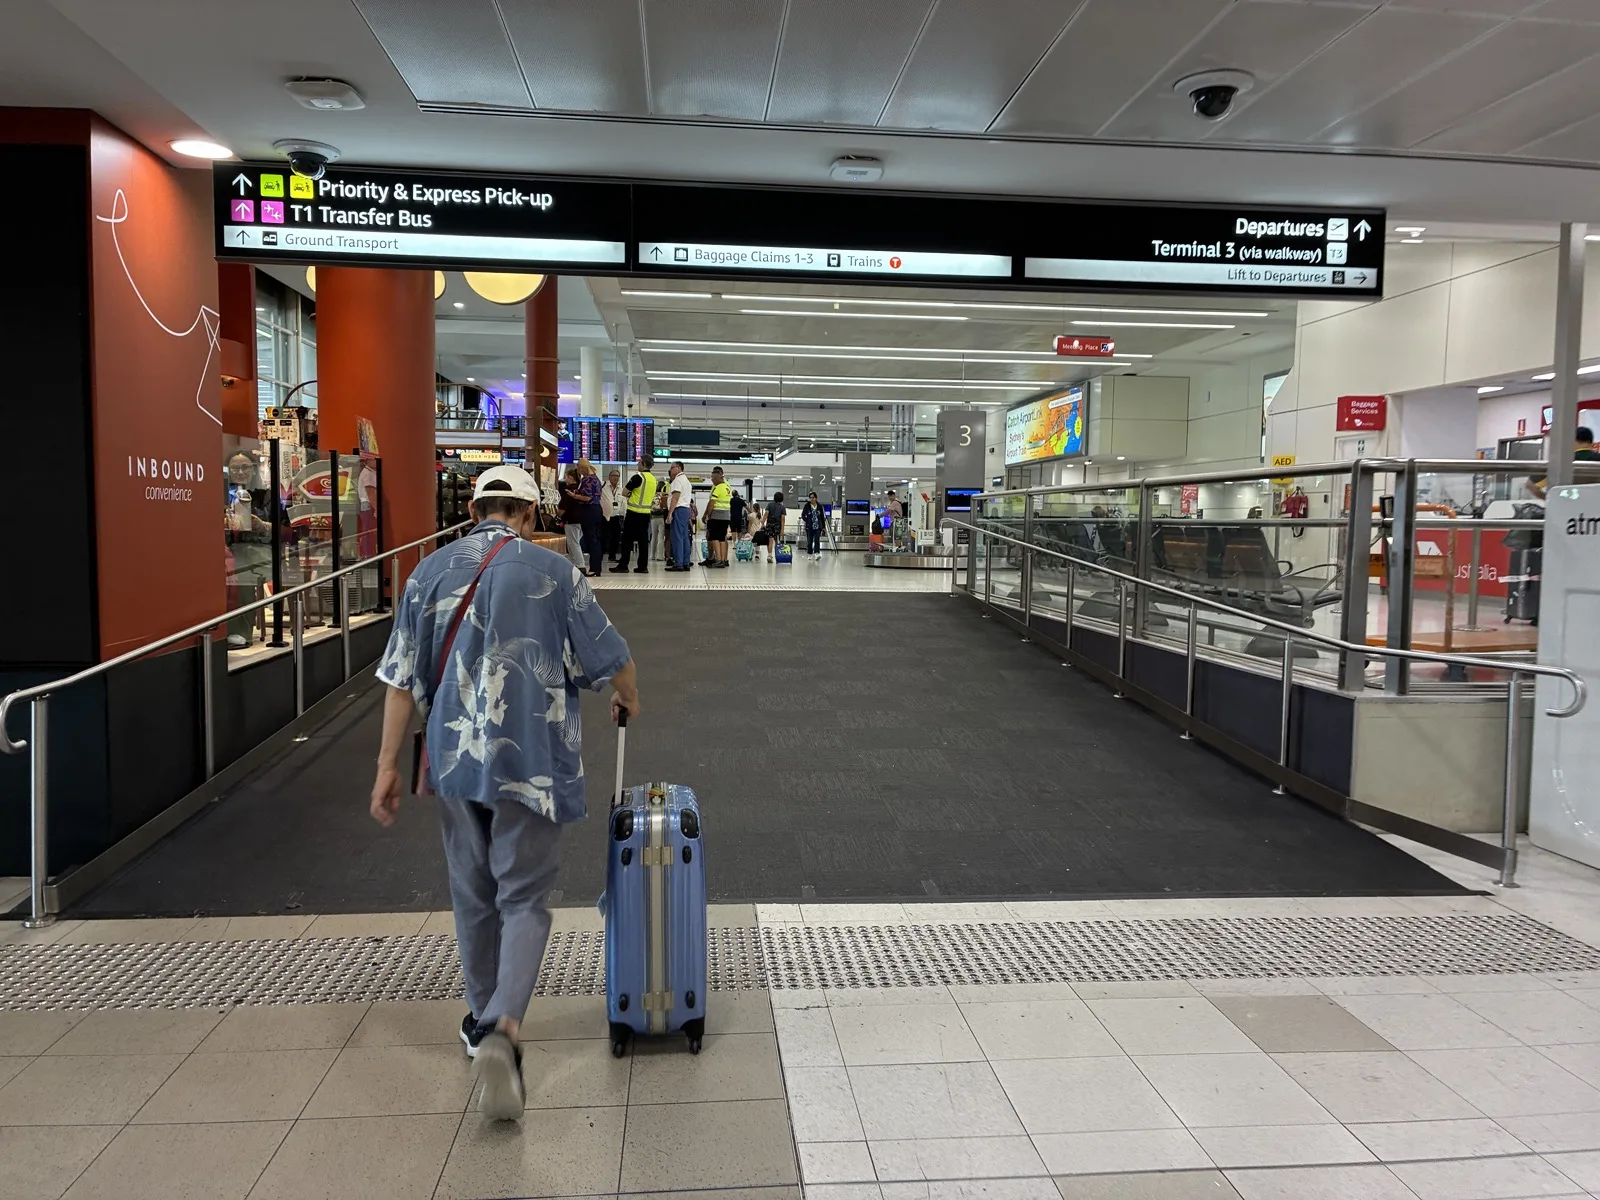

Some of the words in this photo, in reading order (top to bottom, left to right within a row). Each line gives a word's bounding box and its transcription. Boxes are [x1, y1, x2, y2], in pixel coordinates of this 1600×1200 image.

[319, 181, 389, 202] Priority
[393, 184, 409, 201] &
[413, 185, 481, 206] Express
[485, 188, 553, 211] Pick-up
[290, 205, 313, 223] T1
[318, 206, 394, 227] Transfer
[398, 210, 432, 228] Bus
[1235, 217, 1325, 239] Departures
[285, 233, 333, 248] Ground
[336, 235, 399, 251] Transport
[695, 249, 748, 264] Baggage
[751, 250, 791, 264] Claims
[794, 252, 814, 264] 1-3
[1152, 240, 1222, 259] Terminal
[1225, 242, 1236, 258] 3
[1239, 246, 1263, 262] (via
[1264, 247, 1322, 263] walkway)
[1329, 249, 1344, 259] T3
[847, 255, 882, 268] Trains
[1227, 268, 1248, 281] Lift
[1250, 270, 1261, 281] to
[1264, 271, 1327, 284] Departures
[1062, 343, 1083, 351] Meeng
[1084, 343, 1099, 351] Place
[959, 425, 971, 447] 3
[128, 456, 204, 481] INBOUND
[1274, 458, 1292, 466] AED
[819, 474, 826, 485] 2
[145, 484, 192, 501] convenience
[788, 484, 794, 494] 2
